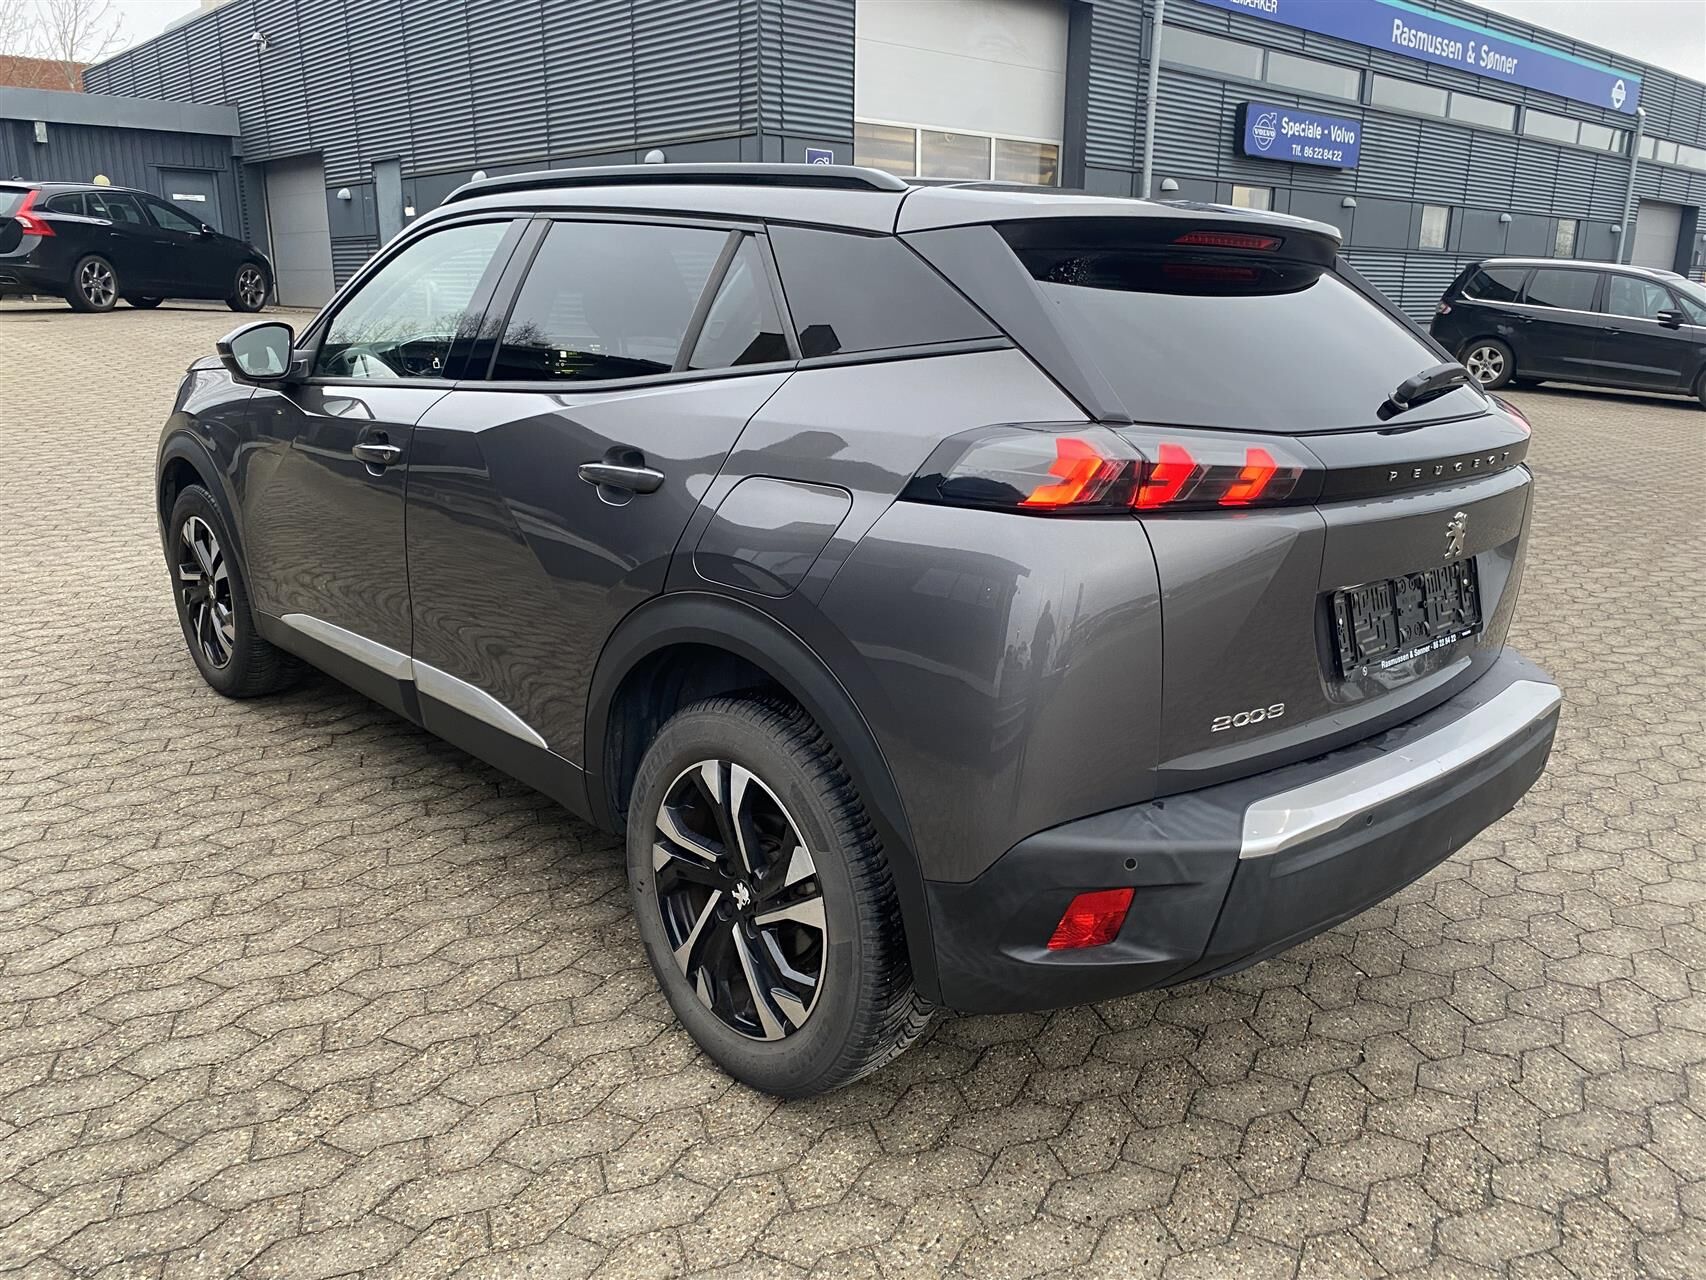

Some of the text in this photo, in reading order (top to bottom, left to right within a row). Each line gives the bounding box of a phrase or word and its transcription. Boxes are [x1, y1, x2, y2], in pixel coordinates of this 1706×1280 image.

[1391, 18, 1518, 75] Rasmussen & Sønner
[1254, 127, 1275, 138] VOLVO
[1281, 117, 1322, 139] Speciale
[1330, 125, 1356, 145] Volvo
[1388, 451, 1510, 482] PEUGEOT
[1381, 653, 1410, 669] Rasmussen
[1210, 702, 1285, 733] 2008
